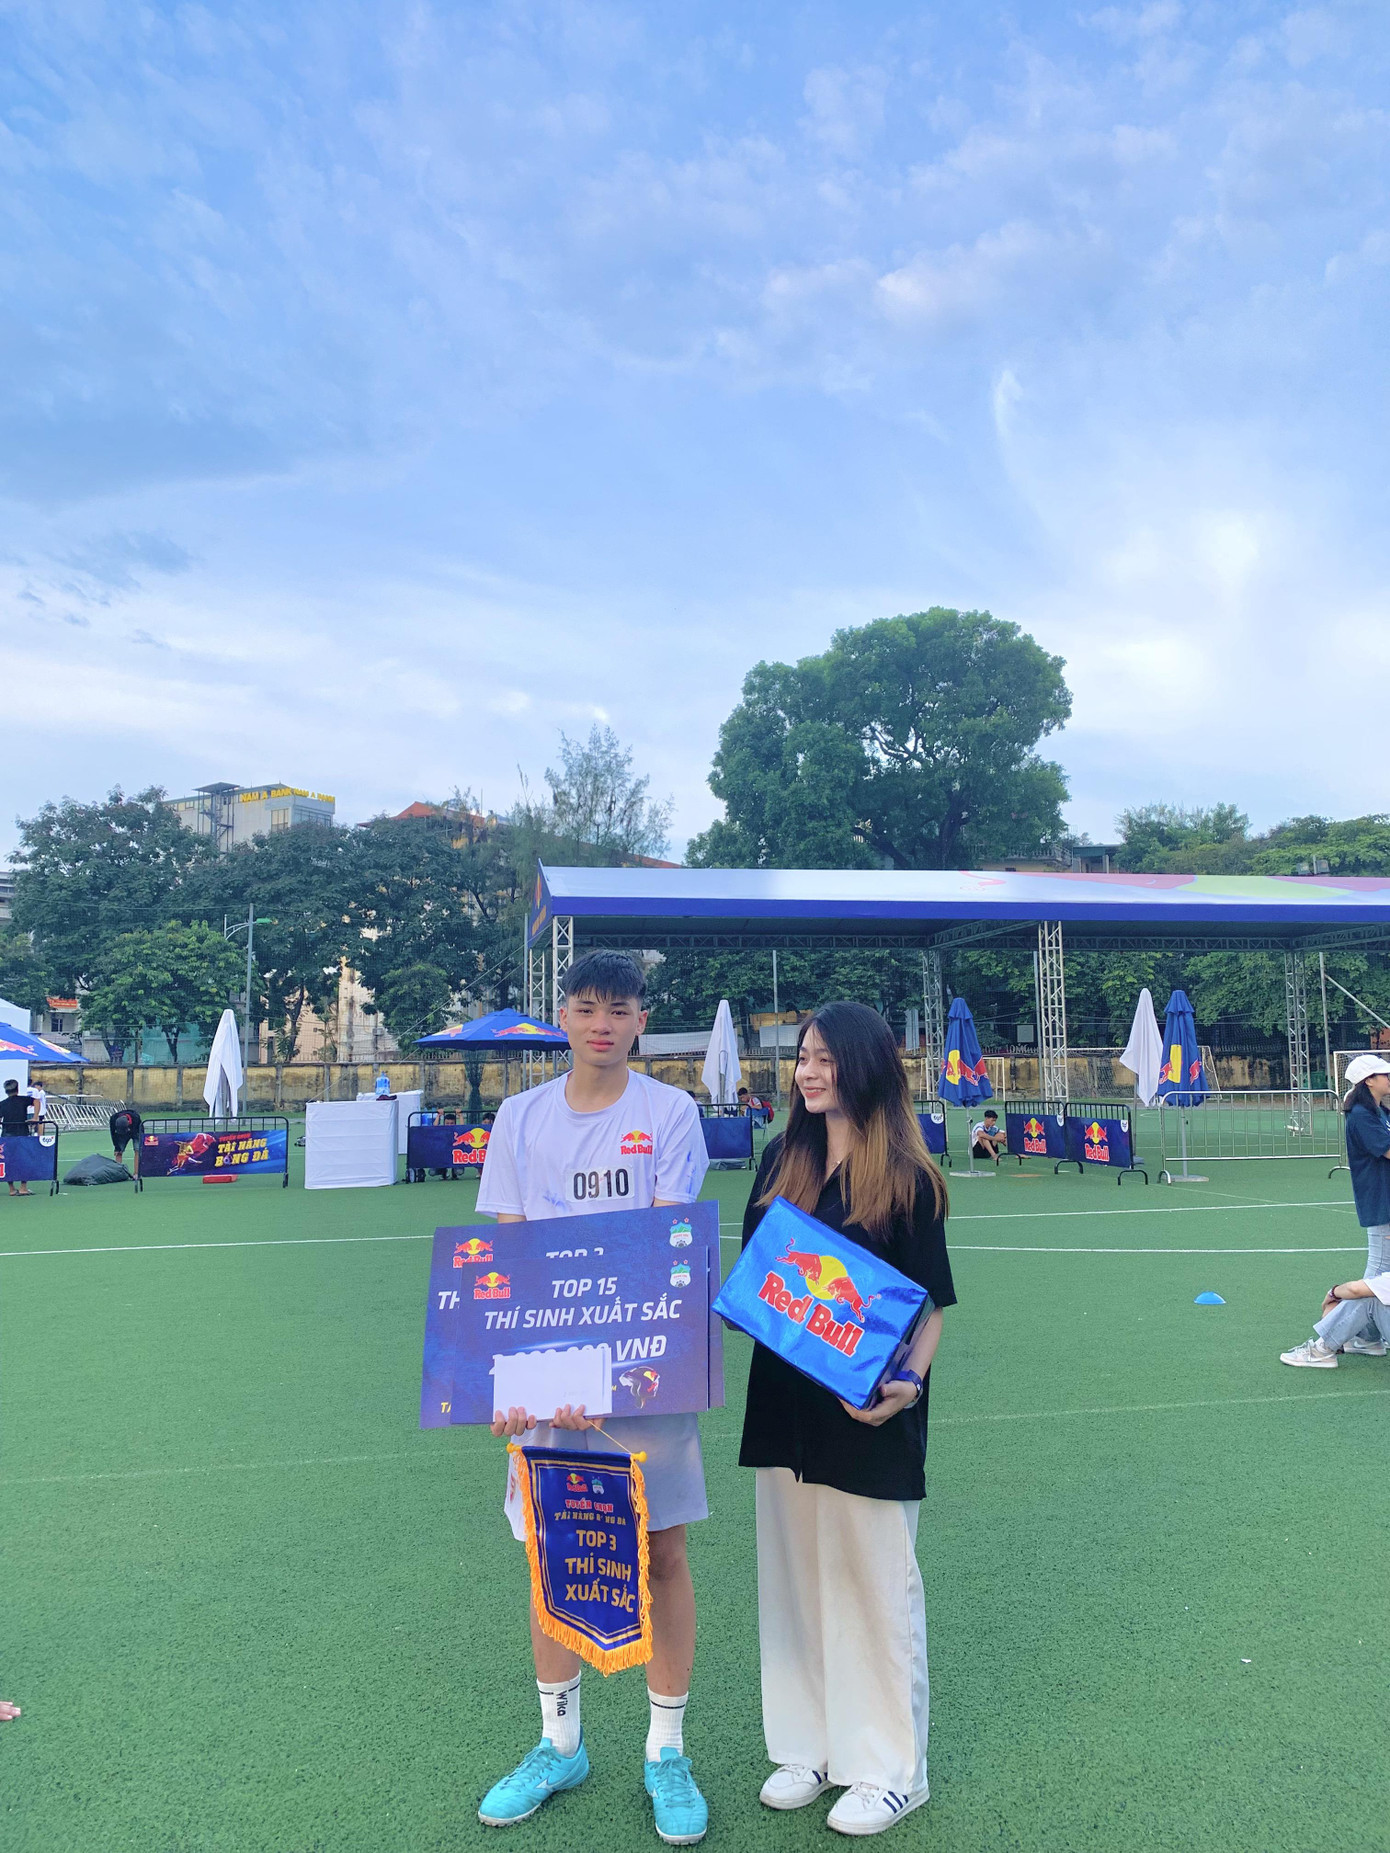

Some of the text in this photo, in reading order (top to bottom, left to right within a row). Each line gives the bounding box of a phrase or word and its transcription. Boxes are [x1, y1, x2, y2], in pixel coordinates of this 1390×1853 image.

[241, 786, 292, 803] NAM A BANK
[452, 1149, 477, 1164] Red
[620, 1144, 653, 1155] Red Bull
[1085, 1143, 1109, 1162] Red Bull
[573, 1168, 629, 1200] 0910
[474, 1287, 511, 1299] Red Bull
[551, 1277, 618, 1298] TOP 15
[484, 1292, 682, 1330] THÍ SINH XUẤT SẮC
[758, 1270, 865, 1358] Red Bull
[616, 1335, 667, 1361] VNĐ
[576, 1529, 617, 1551] TOP 3
[565, 1552, 631, 1582] THÍ SINH
[565, 1577, 635, 1613] XUẤT SẮC
